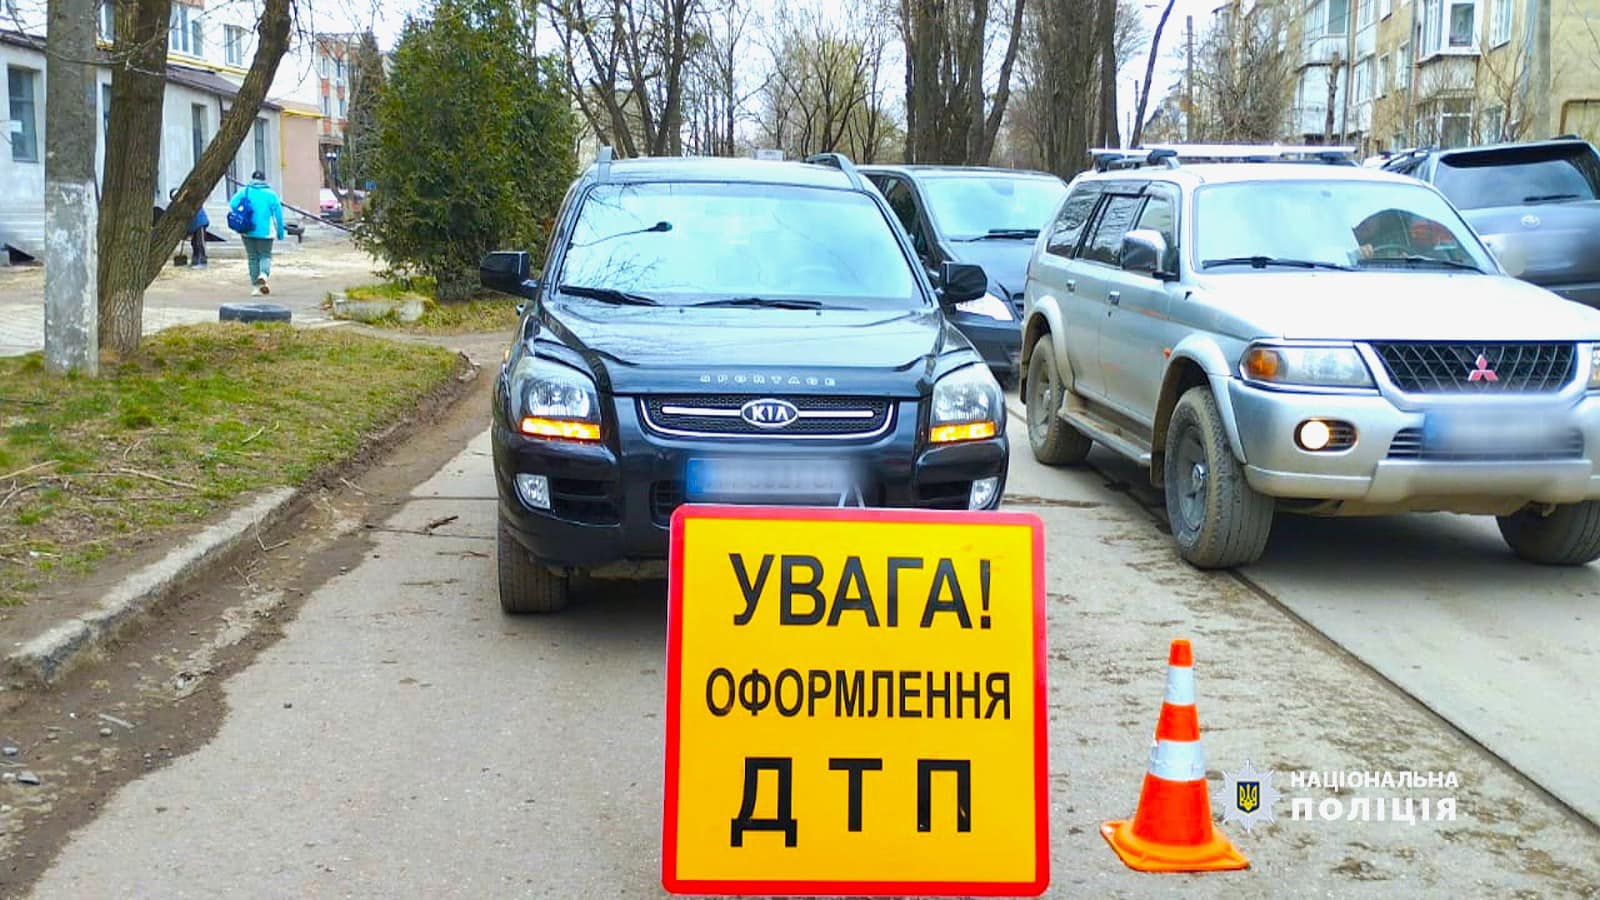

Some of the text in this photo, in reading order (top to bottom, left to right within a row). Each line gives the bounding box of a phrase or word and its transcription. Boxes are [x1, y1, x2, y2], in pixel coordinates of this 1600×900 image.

[751, 405, 790, 422] KIA
[728, 552, 992, 630] УВАГА!
[705, 667, 1012, 720] ОФОРМЛЕННЯ
[730, 756, 972, 848] ДТП
